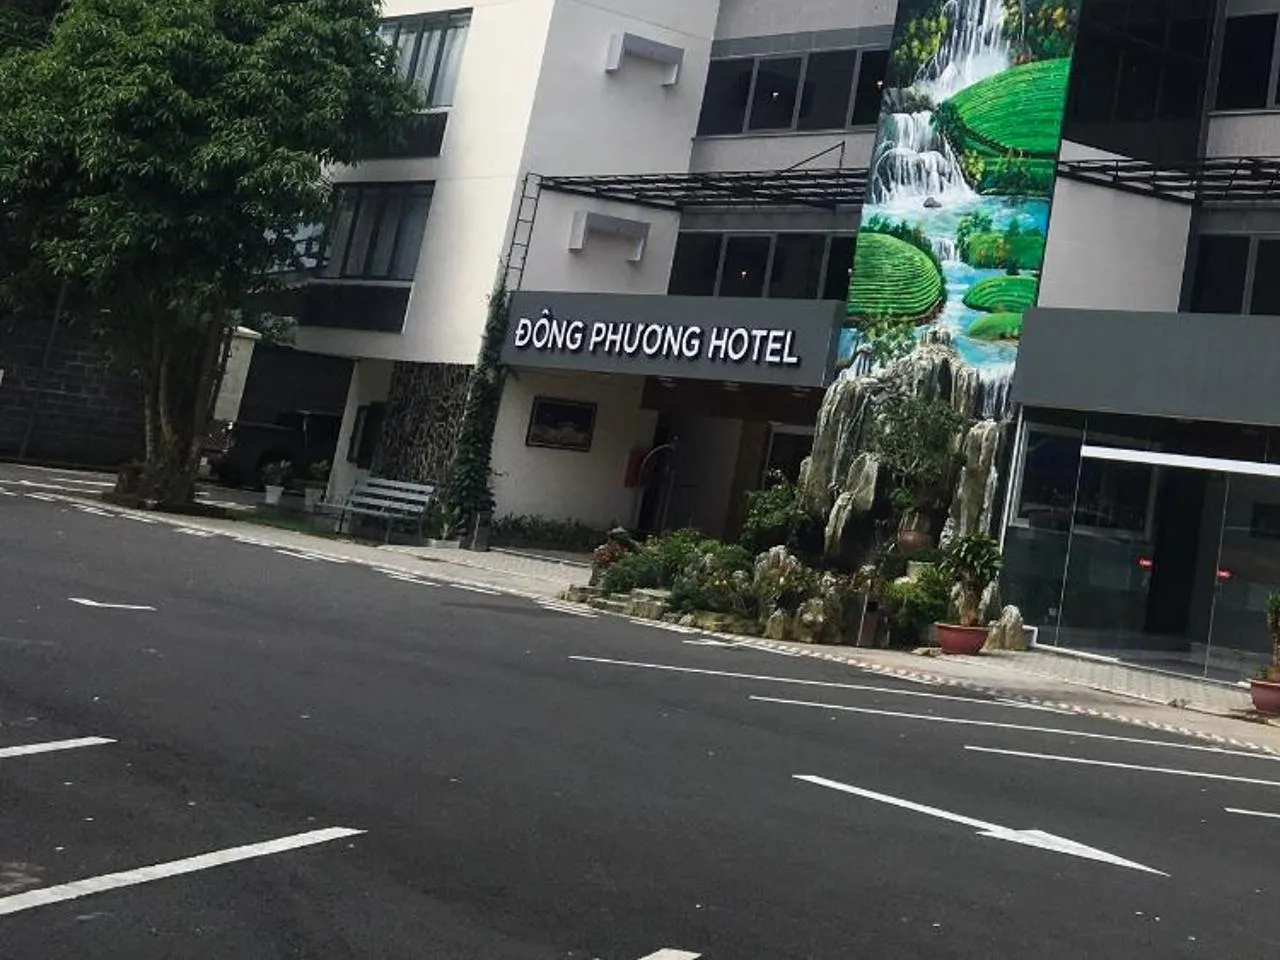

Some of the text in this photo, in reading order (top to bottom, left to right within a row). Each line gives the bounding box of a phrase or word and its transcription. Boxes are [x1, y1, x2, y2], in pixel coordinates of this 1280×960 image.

[515, 308, 798, 363] ĐÔNG PHƯƠNG HOTEL
